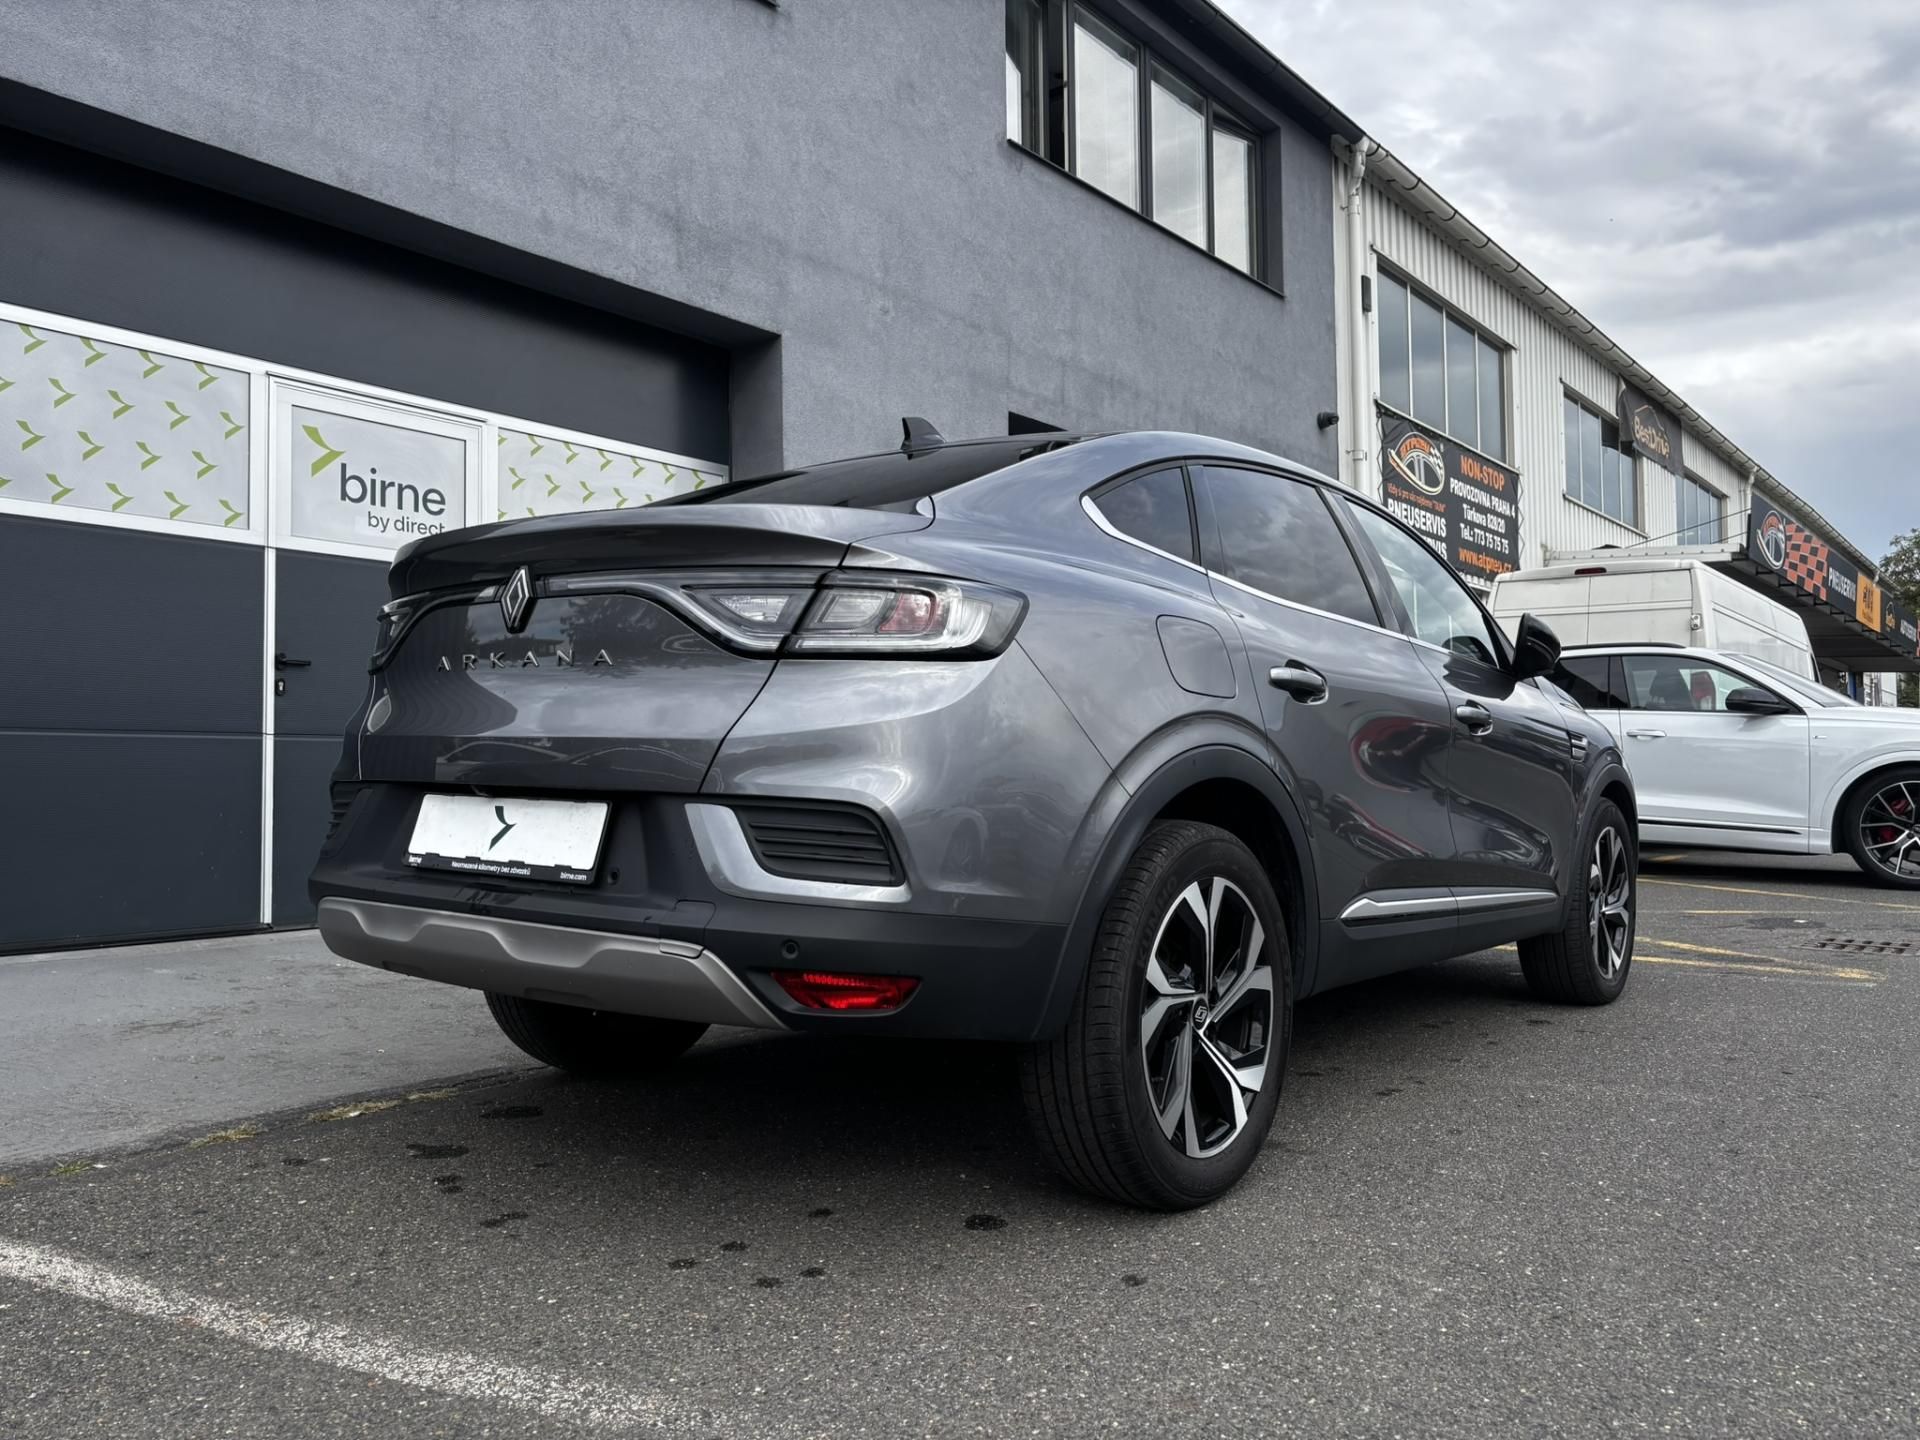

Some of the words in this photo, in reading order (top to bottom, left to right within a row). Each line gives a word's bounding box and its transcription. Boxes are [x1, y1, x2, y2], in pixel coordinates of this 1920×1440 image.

[340, 463, 446, 516] birne
[1460, 455, 1505, 491] NON-STOP
[1450, 477, 1491, 509] PROVOZOVNA
[1491, 496, 1511, 517] PRAHA
[1511, 504, 1516, 519] 4
[368, 511, 390, 533] by
[394, 516, 446, 536] direct
[1387, 498, 1447, 538] PNEUSERVIS
[1460, 522, 1473, 542] Tel.:
[1474, 528, 1485, 546] 773
[1485, 532, 1494, 549] 75
[1493, 535, 1501, 552] 75
[1501, 538, 1509, 554] 75
[438, 649, 614, 672] ARKANA
[560, 872, 587, 881] birne.com
[1136, 876, 1177, 968] KUMHO
